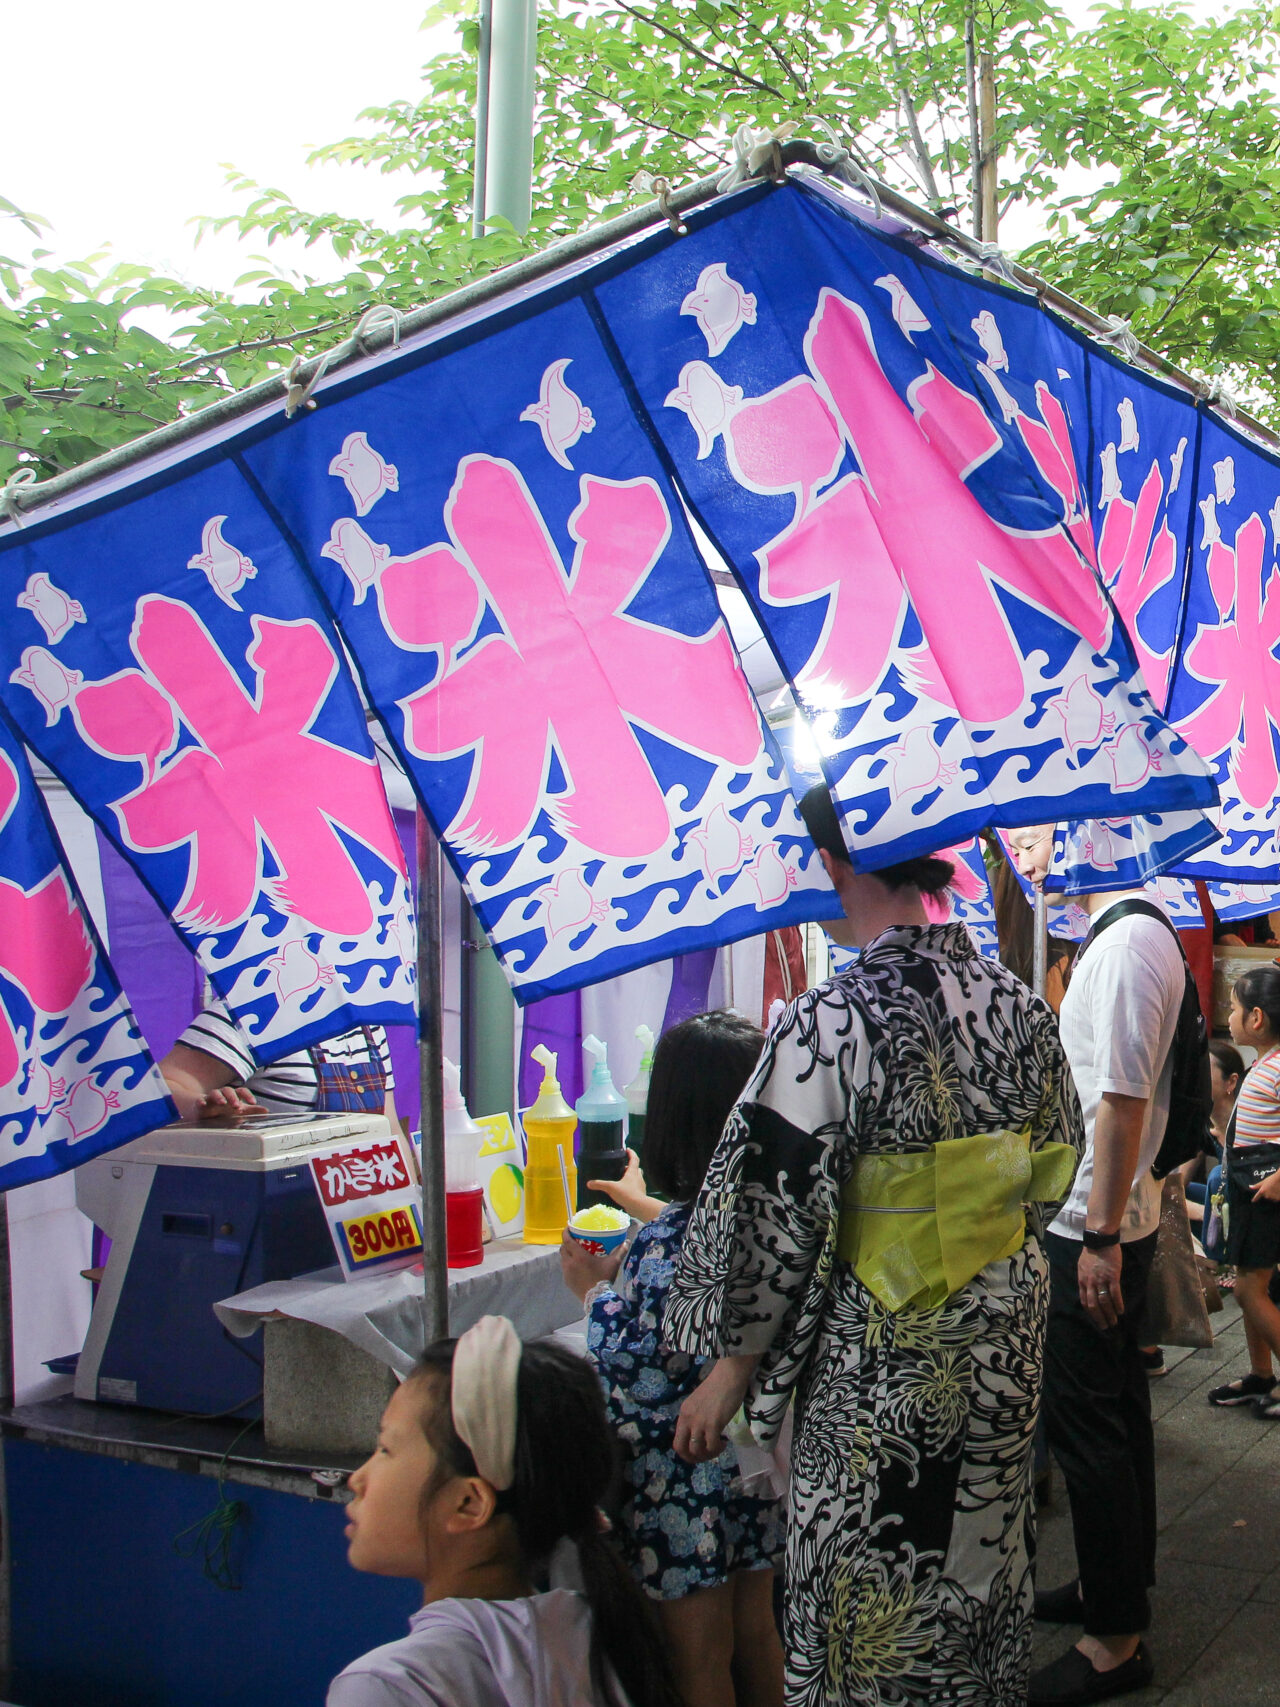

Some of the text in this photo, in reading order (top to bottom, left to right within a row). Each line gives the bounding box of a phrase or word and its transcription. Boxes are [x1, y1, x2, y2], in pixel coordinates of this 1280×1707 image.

[379, 453, 765, 858] 氷
[723, 288, 1113, 724] 氷
[75, 594, 408, 935] 氷
[322, 1152, 405, 1198] かき氷
[348, 1210, 416, 1256] 300円
